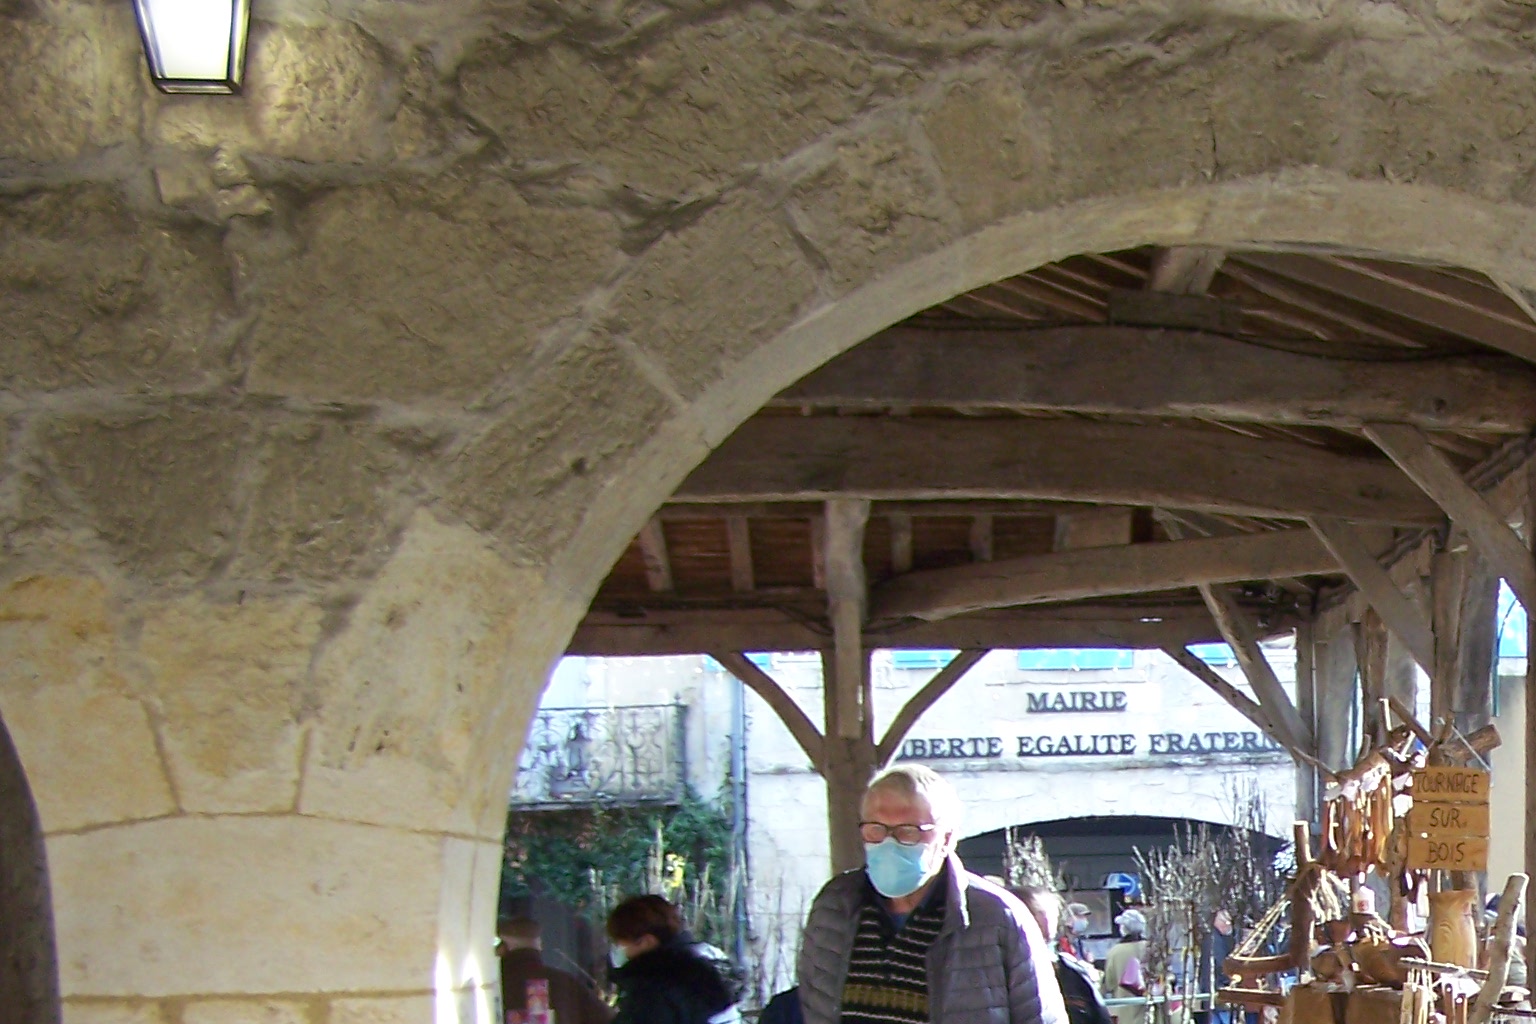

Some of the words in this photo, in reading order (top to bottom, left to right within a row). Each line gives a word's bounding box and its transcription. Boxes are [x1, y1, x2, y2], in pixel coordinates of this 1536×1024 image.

[1026, 691, 1127, 713] MAIRIE
[896, 736, 1004, 761] IBERTE
[1017, 734, 1137, 756] EGALITE
[1415, 771, 1480, 794] TOURNAGE
[1426, 841, 1466, 864] BOIS
